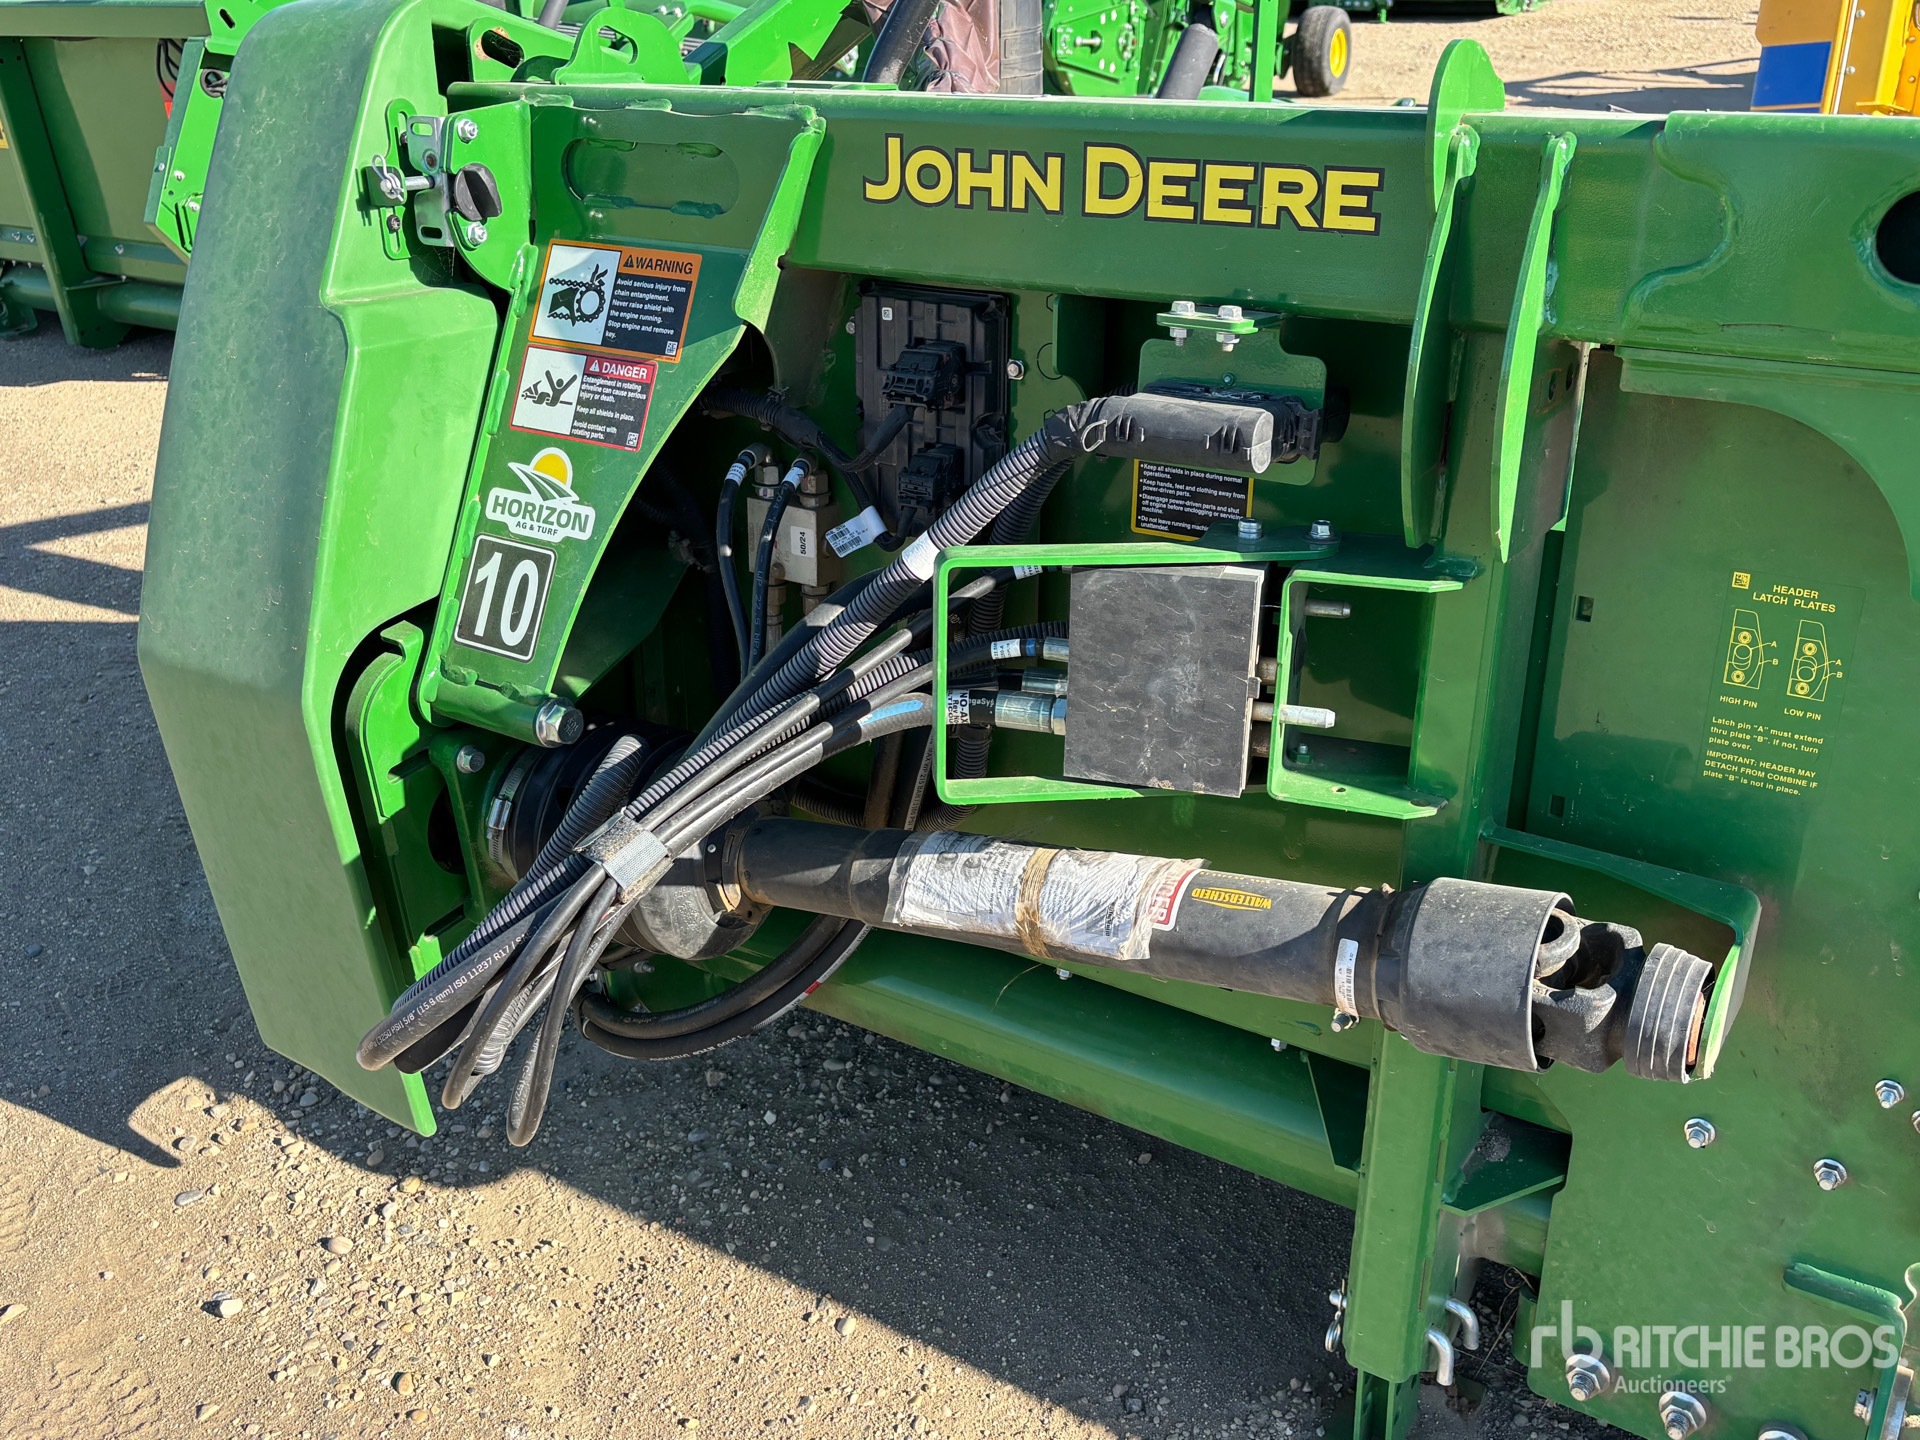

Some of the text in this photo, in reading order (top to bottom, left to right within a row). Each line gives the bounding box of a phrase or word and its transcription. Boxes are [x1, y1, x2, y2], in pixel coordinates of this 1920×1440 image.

[864, 133, 1385, 235] JOHN DEERE
[636, 257, 693, 274] WARNING
[655, 283, 671, 292] injury
[631, 292, 669, 301] entanglement.
[608, 320, 620, 328] Stop
[640, 314, 662, 323] running.
[602, 362, 647, 379] DANGER
[581, 384, 602, 392] driveline
[583, 376, 616, 386] Entanglement
[622, 383, 641, 392] rotating
[580, 391, 593, 400] injury
[577, 405, 589, 414] Keep
[597, 409, 613, 417] shields
[573, 420, 587, 428] Avoid
[571, 429, 590, 438] rotating
[1144, 471, 1171, 479] operations.
[1206, 473, 1222, 481] during
[1143, 486, 1176, 495] power-driven
[1196, 487, 1217, 496] clothing
[1219, 491, 1232, 499] away
[1143, 494, 1168, 502] Disengage
[1169, 498, 1202, 506] power-driven
[1203, 502, 1216, 510] parts
[492, 495, 590, 532] HORIZON
[1184, 507, 1212, 517] unclogging
[516, 521, 527, 529] AG
[537, 525, 558, 536] TURF
[1141, 523, 1169, 531] unattended.
[1172, 520, 1191, 529] running
[1773, 585, 1818, 599] HEADER
[474, 552, 539, 647] 10
[1753, 592, 1835, 612] LATCH PLATES
[1720, 696, 1757, 708] HIGH PIN
[1784, 708, 1821, 720] LOW PIN
[1713, 717, 1735, 726] Latch
[1738, 722, 1751, 730] pin
[1771, 729, 1791, 738] must
[1794, 733, 1823, 744] extend
[1709, 737, 1752, 750] plate over.
[1711, 726, 1727, 735] thru
[1730, 730, 1751, 740] plate
[1782, 741, 1798, 750] not,
[1801, 745, 1818, 753] turn
[1707, 750, 1816, 778] IMPORTANT: HEADER MAY
[1705, 760, 1737, 772] DETACH
[1740, 767, 1765, 778] FROM
[1767, 773, 1807, 786] COMBINE
[1703, 770, 1723, 779] plate
[1776, 784, 1800, 795] place.
[1192, 887, 1272, 909] WALTERSCHEID
[435, 984, 454, 1003] mm)
[452, 975, 468, 990] ISO
[467, 957, 493, 980] 11237
[493, 945, 511, 962] R17
